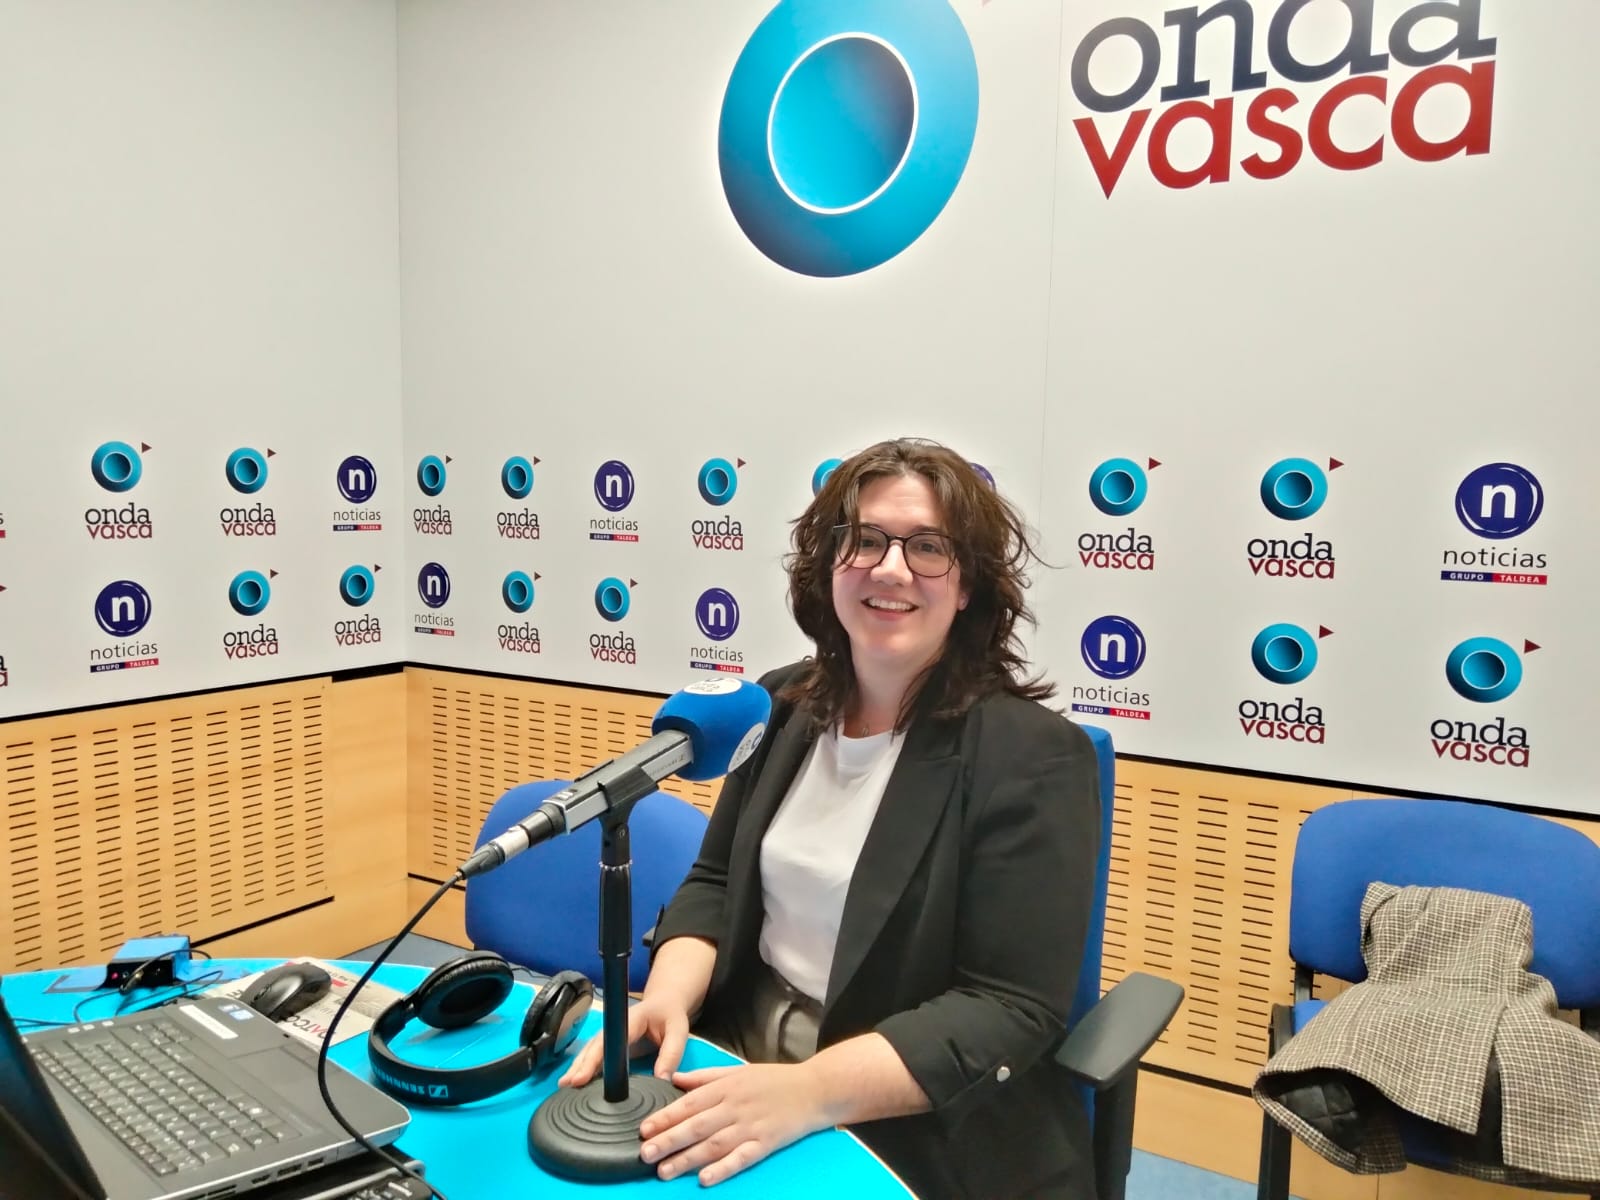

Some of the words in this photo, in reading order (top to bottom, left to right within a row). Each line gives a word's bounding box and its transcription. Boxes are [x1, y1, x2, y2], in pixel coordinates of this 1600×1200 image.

[1073, 60, 1496, 200] vasca
[348, 468, 366, 491] n
[606, 474, 623, 498] n
[1480, 483, 1517, 519] n
[85, 502, 153, 526] onda
[220, 502, 275, 523] onda
[333, 508, 381, 521] noticias
[413, 504, 452, 524] onda
[497, 508, 540, 528] onda
[86, 523, 153, 540] vasca
[221, 520, 276, 537] vasca
[414, 520, 452, 535] vasca
[497, 523, 540, 540] vasca
[590, 516, 639, 531] noticias
[691, 515, 744, 537] onda
[692, 533, 744, 551] vasca
[1077, 527, 1154, 555] onda
[1247, 532, 1335, 562] onda
[1079, 550, 1154, 571] vasca
[1248, 556, 1335, 580] vasca
[1443, 546, 1547, 569] noticias
[427, 574, 441, 597] n
[1449, 572, 1484, 581] GRUPO
[1500, 574, 1540, 584] TALDEA
[112, 595, 136, 622] n
[708, 602, 727, 627] n
[334, 613, 381, 636] onda
[415, 612, 454, 627] noticias
[223, 623, 278, 646] onda
[335, 629, 382, 647] vasca
[498, 622, 540, 642] onda
[590, 631, 635, 651] onda
[90, 640, 158, 661] noticias
[224, 641, 279, 660] vasca
[498, 637, 541, 654] vasca
[590, 647, 637, 665] vasca
[690, 645, 744, 663] noticias
[1099, 633, 1126, 663] n
[1072, 685, 1150, 706] noticias
[1078, 705, 1104, 714] GRUPO
[1115, 709, 1145, 719] TALDEA
[1238, 697, 1325, 727] onda
[1240, 718, 1326, 745] vasca
[1430, 716, 1530, 749] onda
[1431, 738, 1530, 768] vasca
